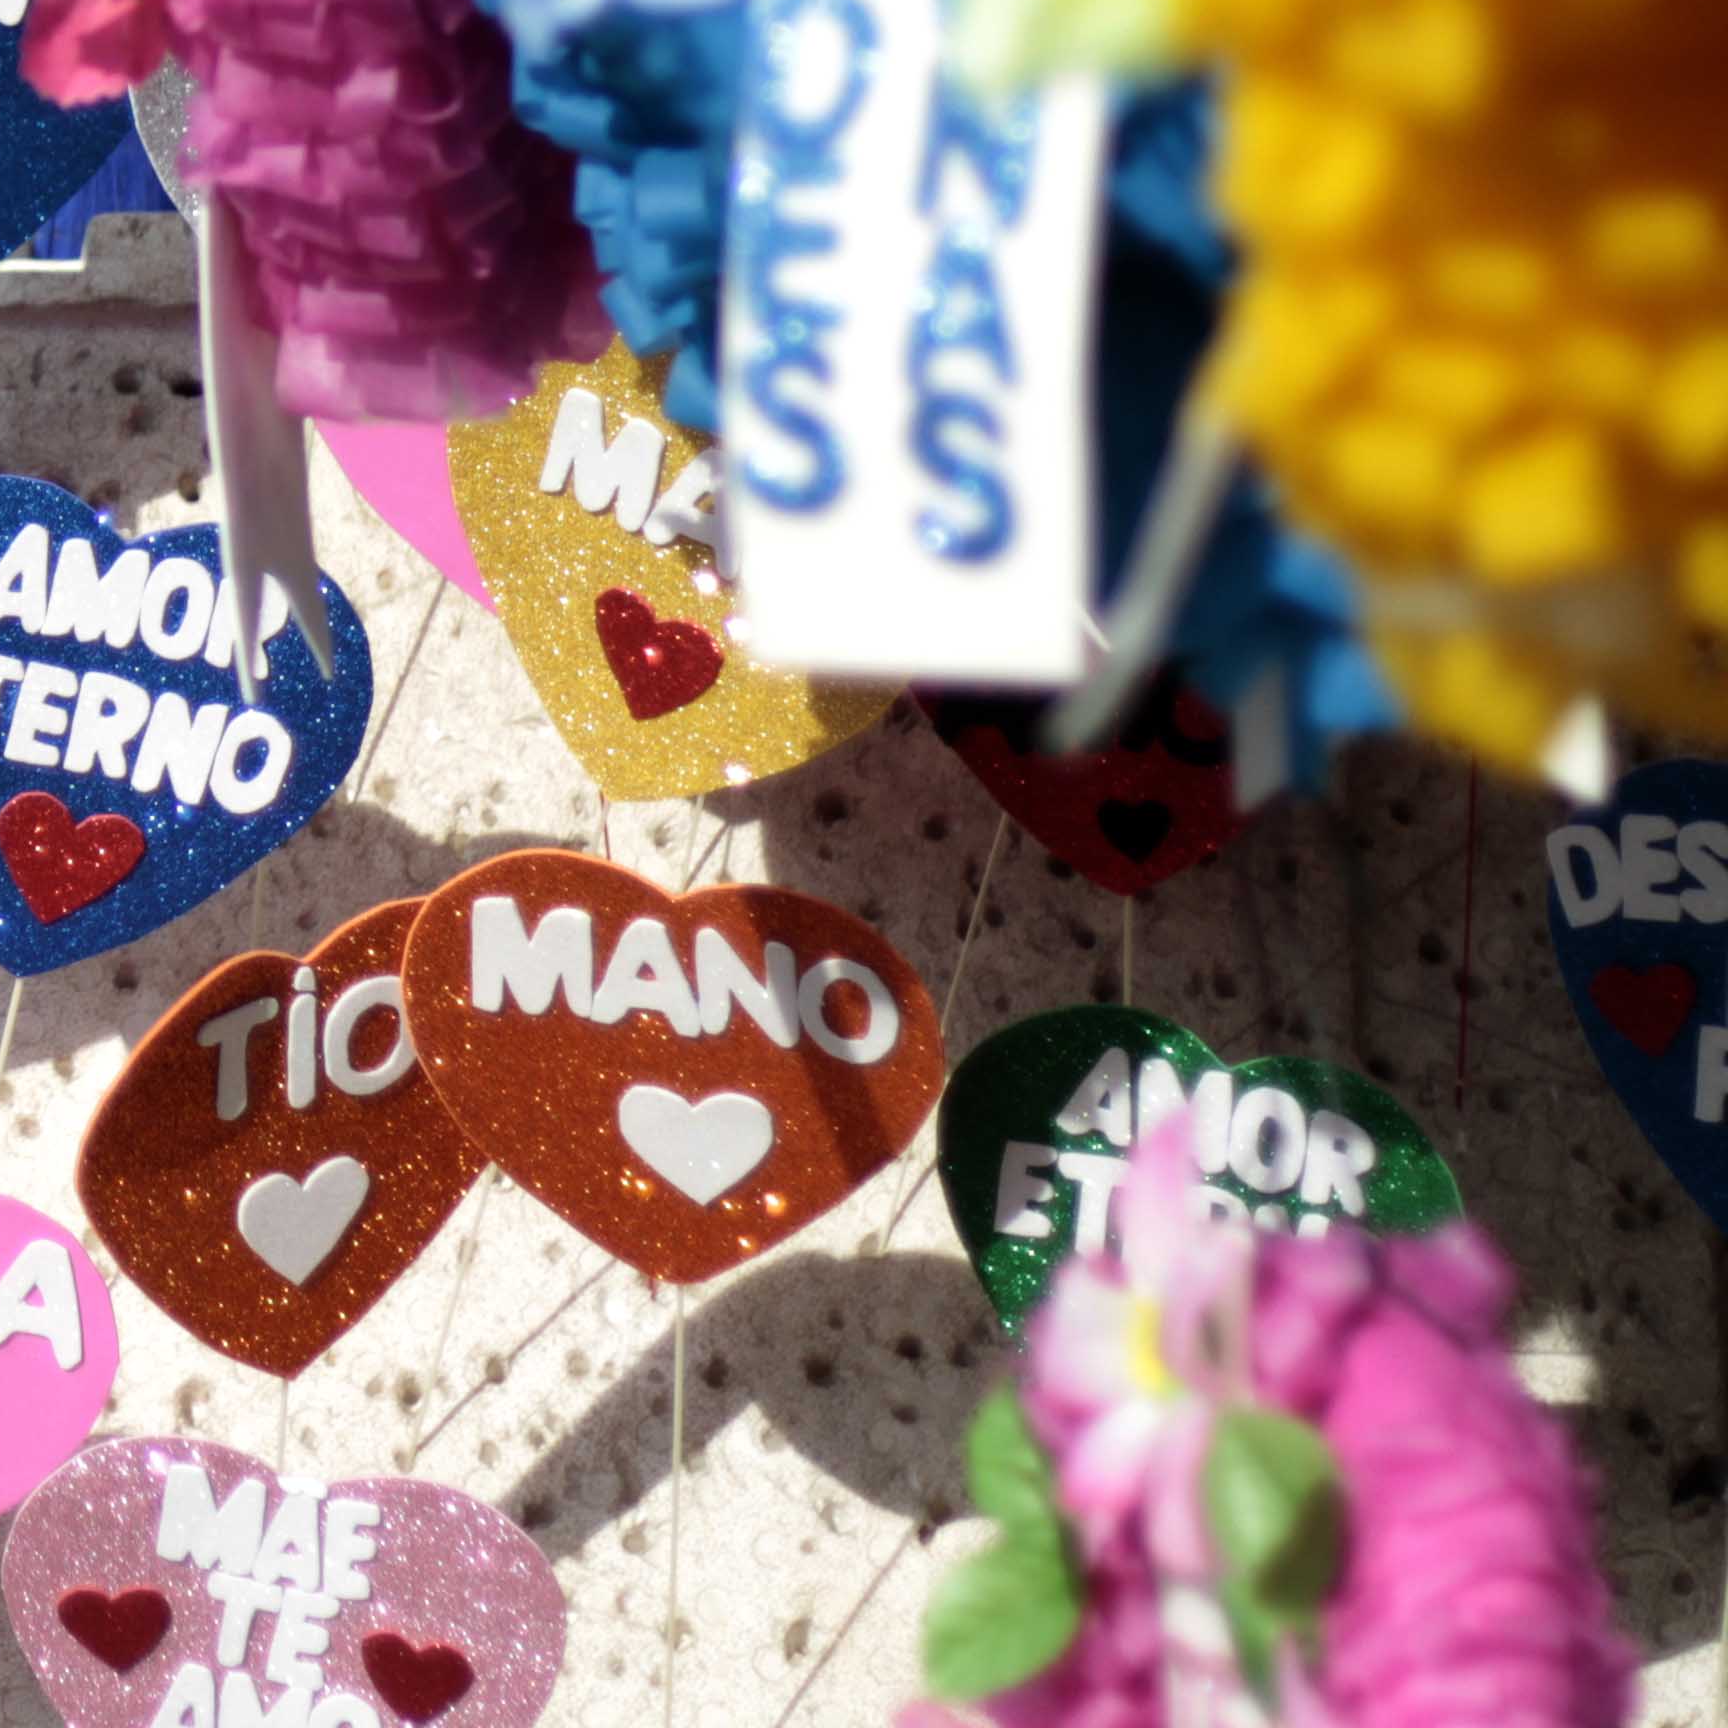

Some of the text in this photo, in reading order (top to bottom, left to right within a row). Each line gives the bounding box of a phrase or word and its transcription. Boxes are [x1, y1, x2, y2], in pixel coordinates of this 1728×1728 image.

[470, 896, 900, 1065] MANO
[1055, 1047, 1377, 1217] AMOR
[207, 1572, 340, 1689] TE
